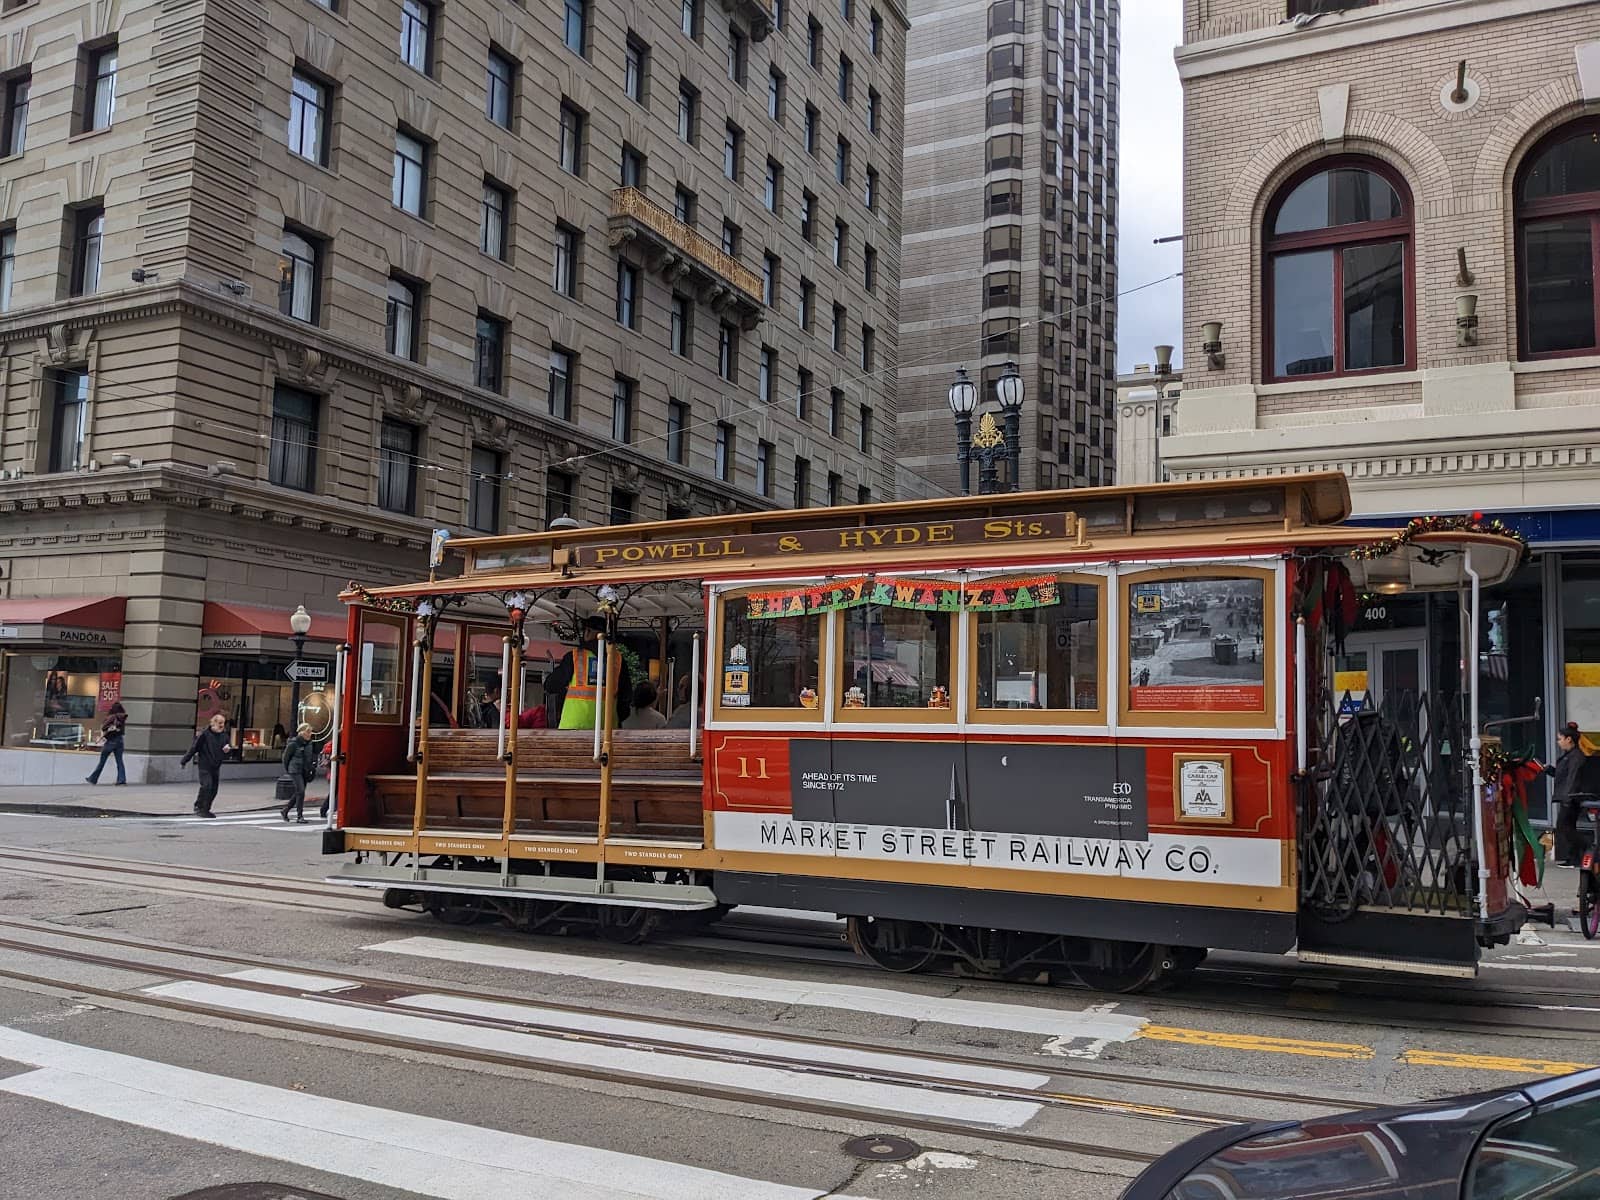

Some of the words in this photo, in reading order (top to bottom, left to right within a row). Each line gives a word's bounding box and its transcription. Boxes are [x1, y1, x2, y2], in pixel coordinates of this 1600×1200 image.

[595, 540, 745, 563] POWELL
[778, 536, 803, 552] &
[839, 524, 954, 548] HYDE
[984, 520, 1051, 539] Sts.
[767, 583, 863, 612] HAPPY
[874, 583, 1033, 605] KWANZAA
[1365, 607, 1386, 620] 400
[101, 681, 119, 690] SALE
[737, 757, 770, 779] 11
[802, 772, 829, 781] AHEAD
[829, 773, 841, 781] OF
[843, 774, 856, 782] ITS
[857, 774, 877, 783] TIME
[802, 781, 826, 790] SINCE
[827, 782, 845, 791] 1972
[761, 821, 868, 851] MARKET
[882, 829, 997, 860] STREET
[1010, 836, 1152, 870] RAILWAY
[1165, 846, 1219, 874] CO.
